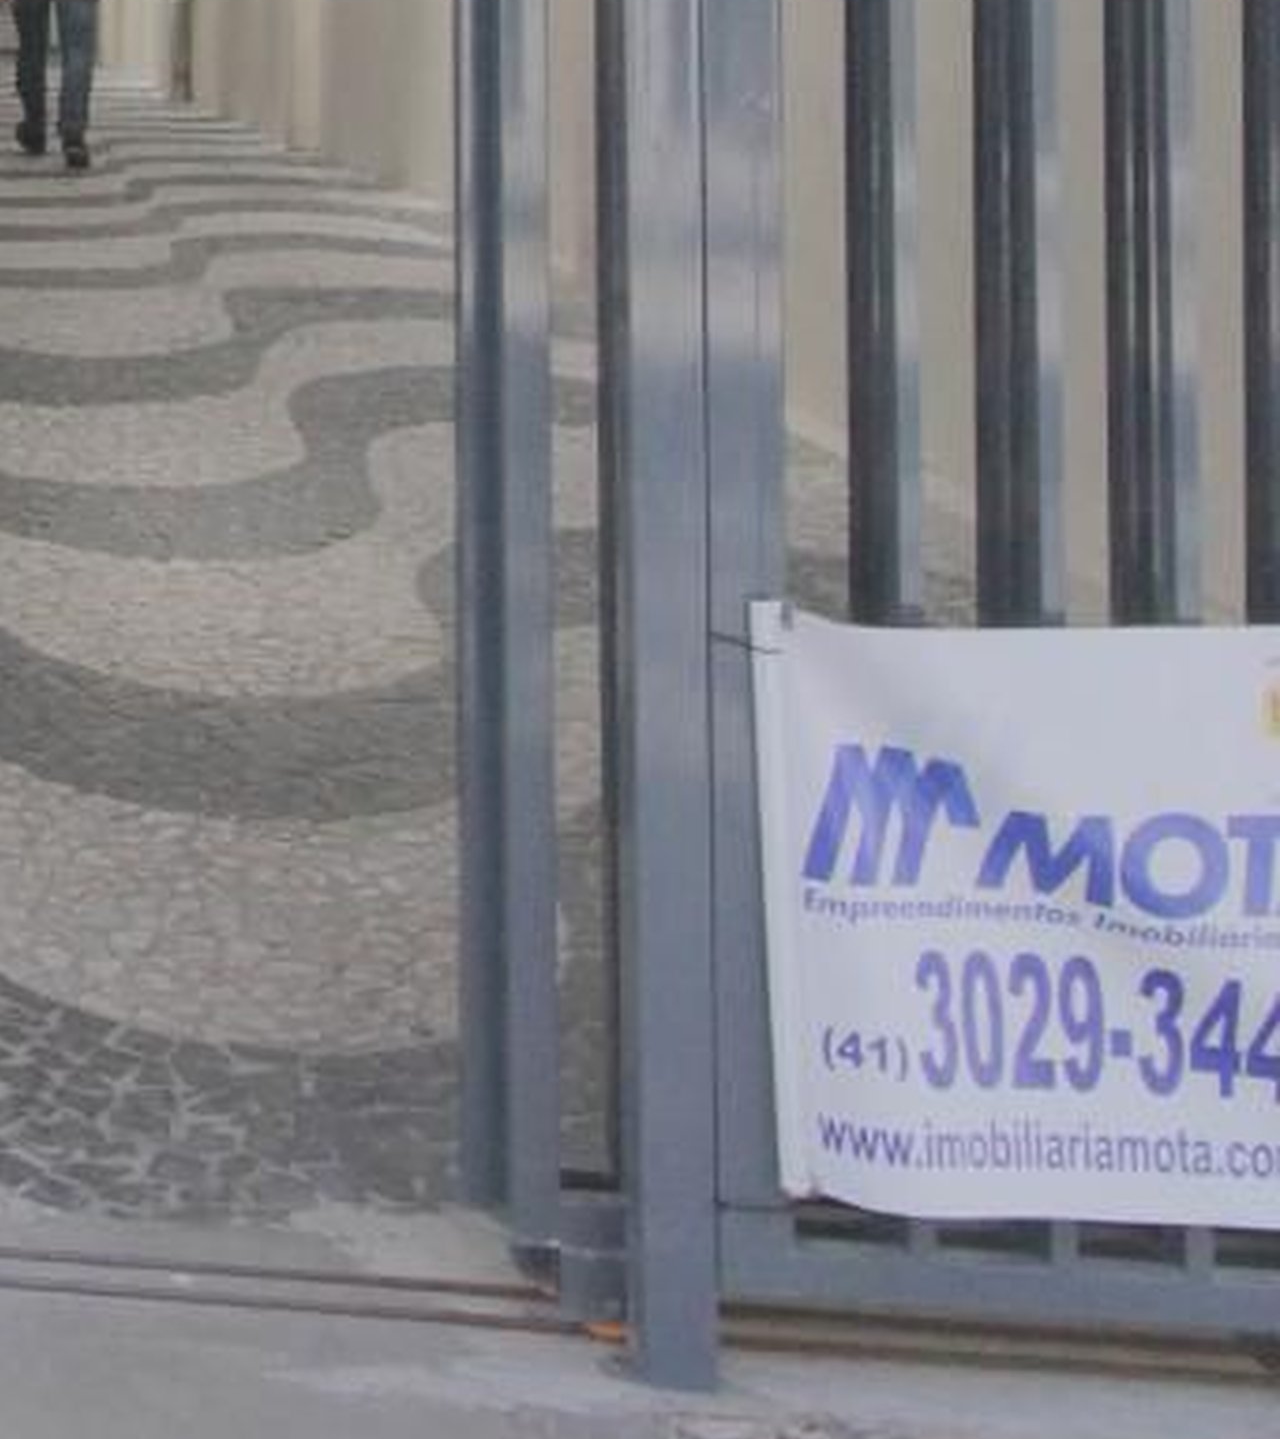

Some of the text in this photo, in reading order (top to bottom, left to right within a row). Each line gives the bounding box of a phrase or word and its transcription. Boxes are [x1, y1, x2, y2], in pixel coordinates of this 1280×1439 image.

[802, 886, 1081, 925] Empreendimentos
[976, 810, 1280, 920] MOT
[822, 949, 1280, 1102] (41) 3029-344
[817, 1111, 1280, 1179] www.imobiliariamota.co
